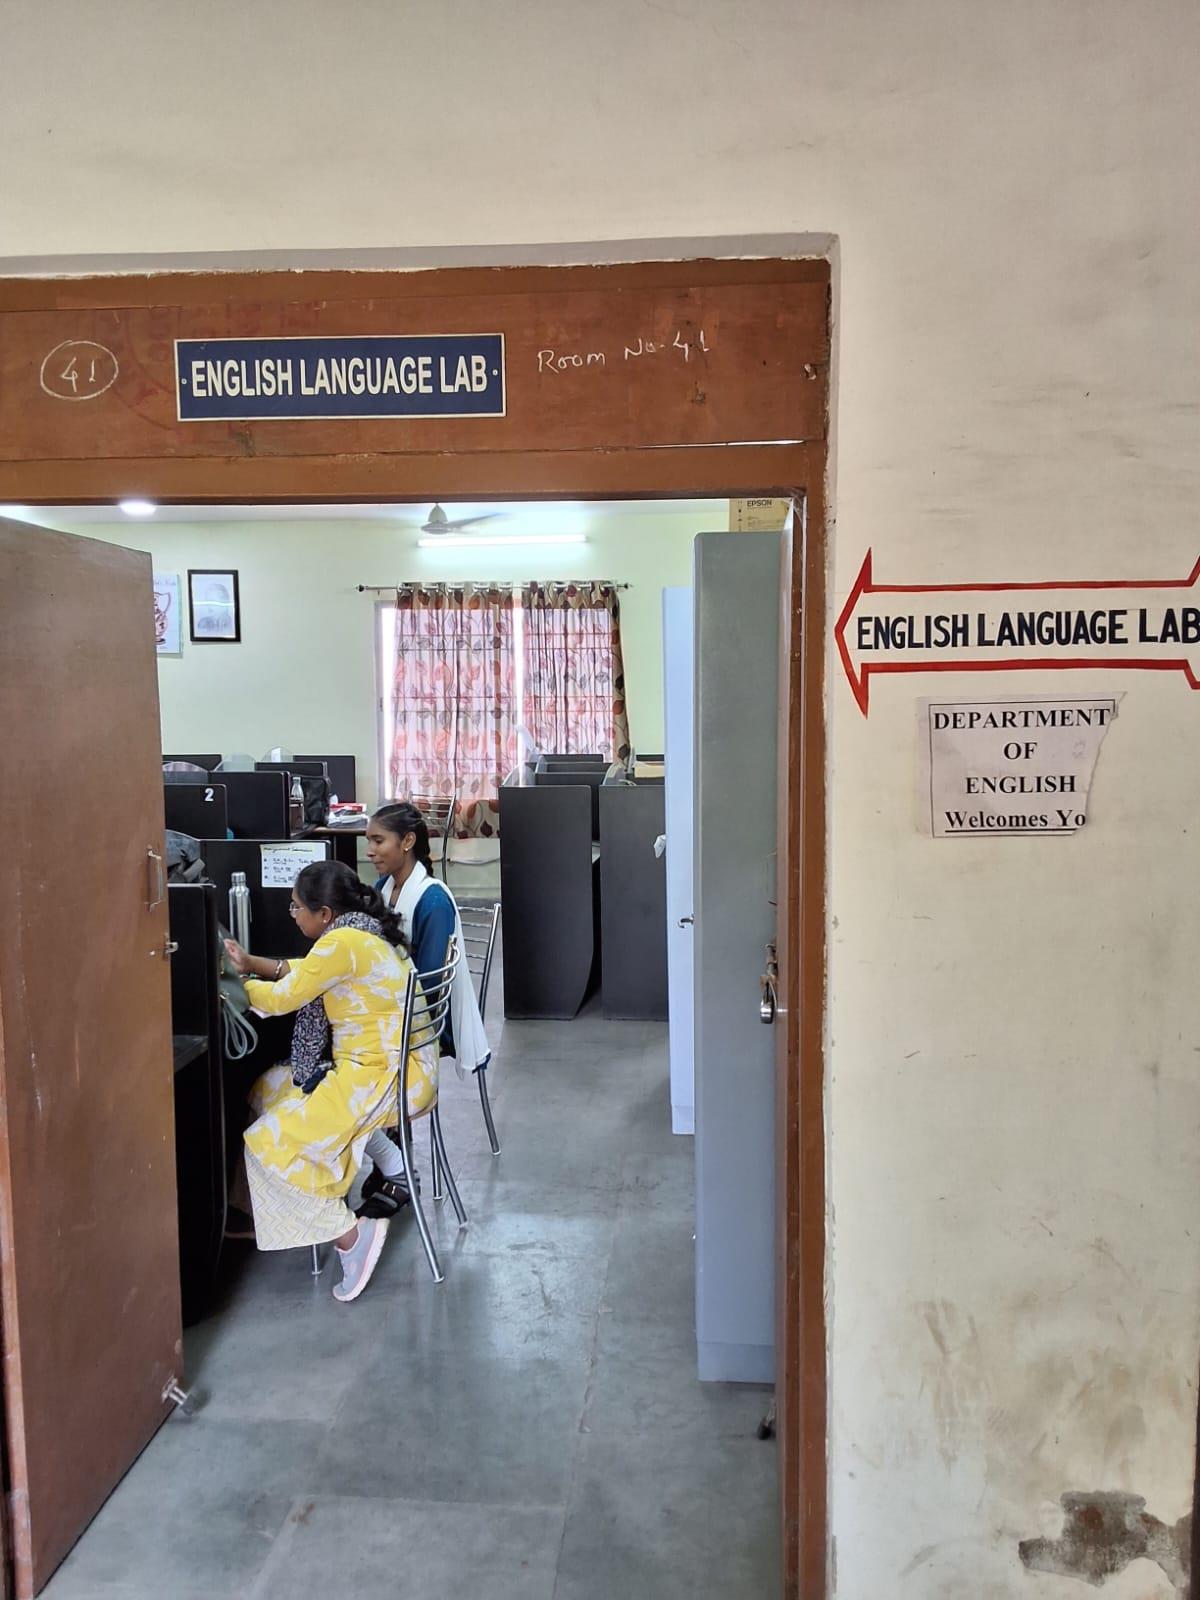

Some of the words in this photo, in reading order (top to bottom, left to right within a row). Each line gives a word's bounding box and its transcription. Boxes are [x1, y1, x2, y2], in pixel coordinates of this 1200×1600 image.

[537, 350, 606, 373] Room
[672, 330, 710, 363] 41
[61, 356, 96, 393] 41
[191, 358, 293, 397] ENGLISH
[300, 356, 433, 396] LANGUAGE
[440, 355, 488, 393] LAB
[746, 499, 773, 507] EPSON
[857, 613, 969, 650] ENGLISH
[977, 610, 1128, 647] LANGUAGE
[1138, 608, 1200, 643] LAB
[933, 707, 1111, 731] DEPARTMENT
[1003, 742, 1038, 760] OF
[204, 787, 215, 802] 2
[965, 775, 1077, 794] ENGLISH
[944, 810, 1049, 829] Welcomes
[1056, 809, 1086, 828] Yo
